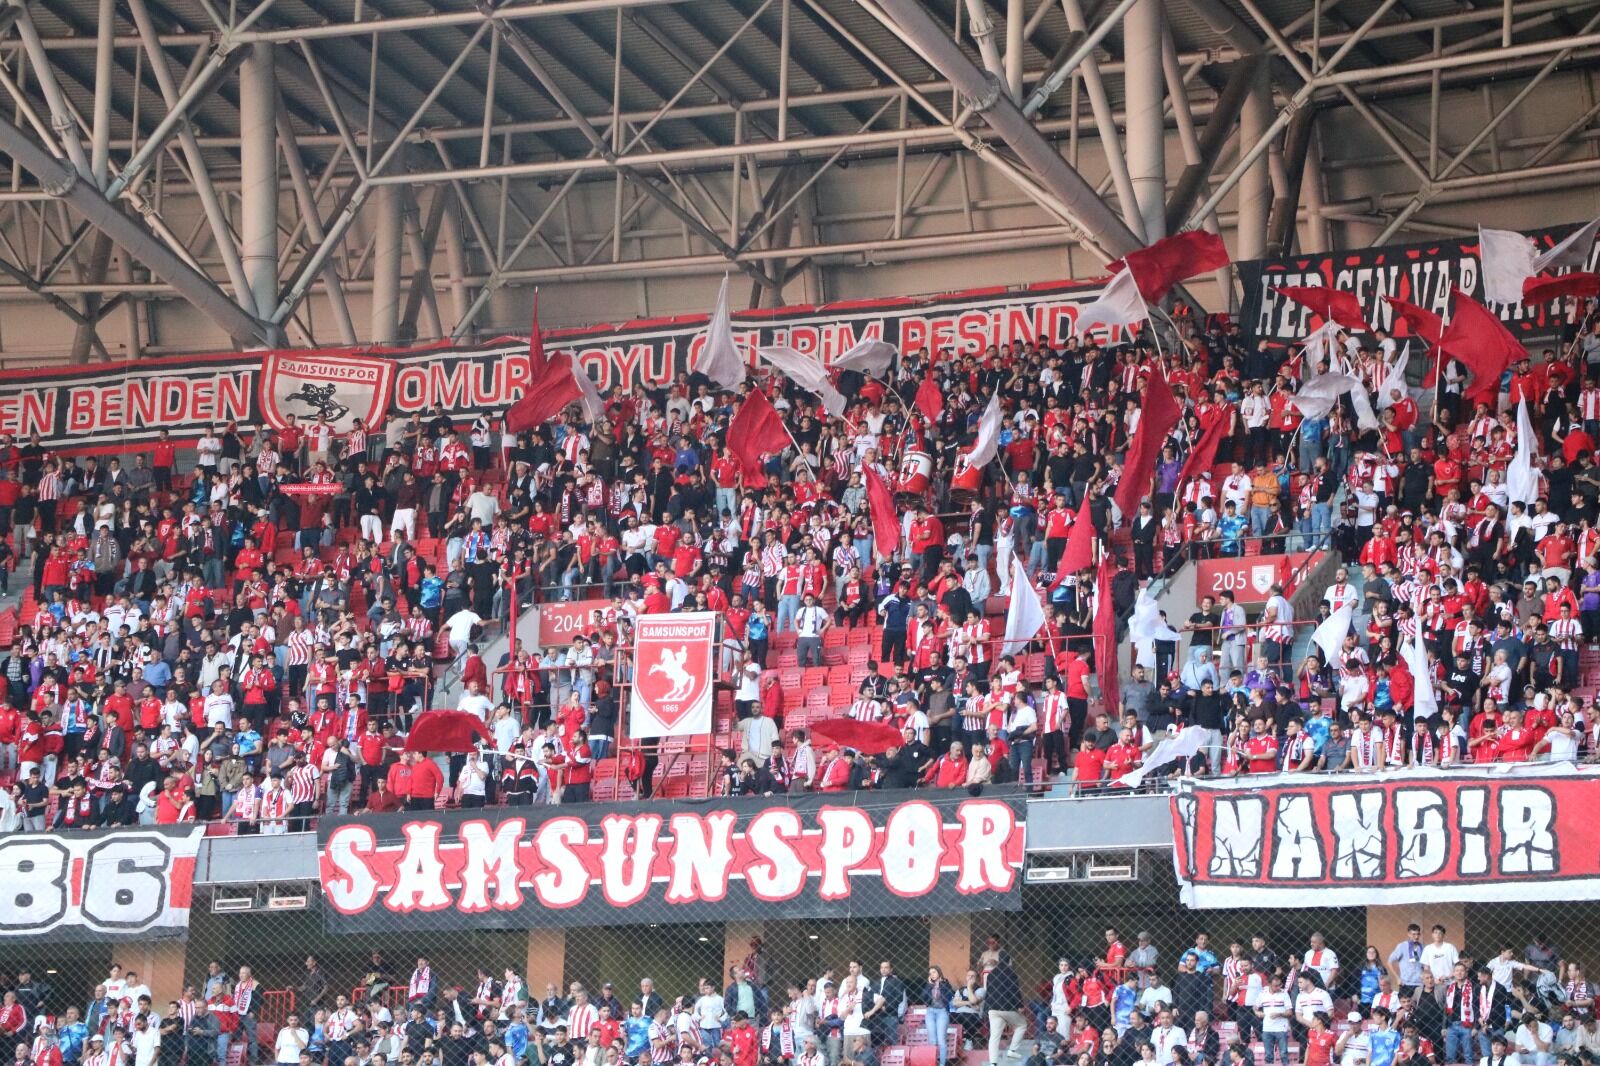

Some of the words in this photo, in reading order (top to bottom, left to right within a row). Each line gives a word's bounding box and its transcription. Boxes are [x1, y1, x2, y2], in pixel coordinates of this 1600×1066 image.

[281, 361, 376, 380] SAMSUNSPOR
[66, 371, 253, 434] BENDEN
[1212, 570, 1247, 591] 205
[553, 613, 584, 633] 204
[642, 625, 707, 637] SAMSUNSPOR
[662, 704, 679, 713] 1965
[322, 800, 1015, 915] SAMSUNSPOR
